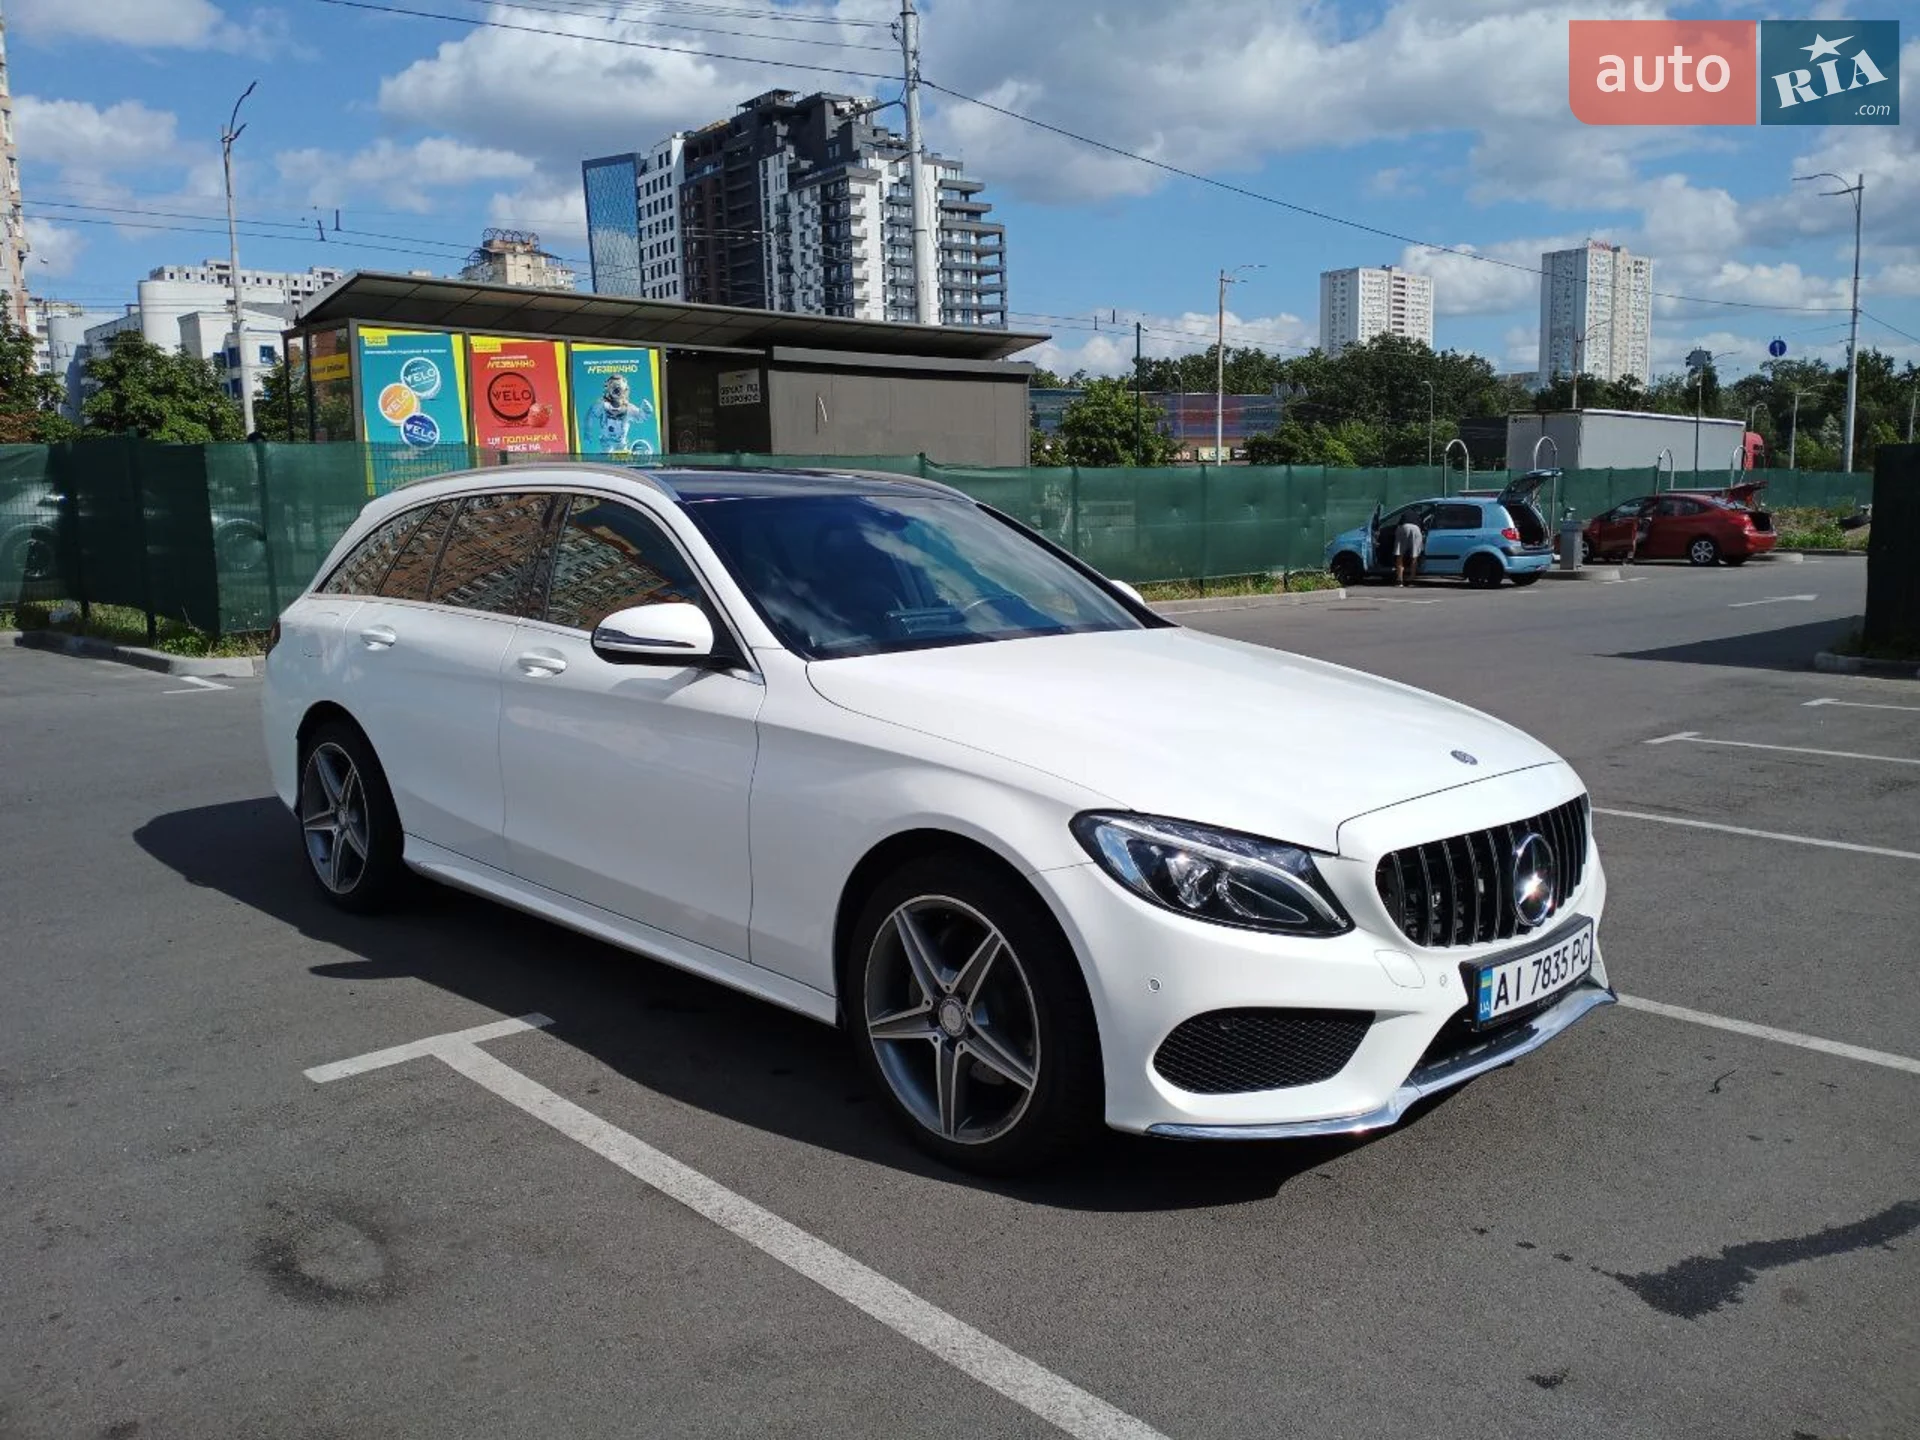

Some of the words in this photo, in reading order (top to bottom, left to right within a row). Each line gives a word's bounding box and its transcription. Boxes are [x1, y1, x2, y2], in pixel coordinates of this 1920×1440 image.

[404, 367, 437, 384] VELO
[385, 389, 411, 415] VELO
[492, 389, 532, 401] VELO
[405, 423, 437, 440] VELO
[502, 433, 558, 445] ПОЛУНИЧКА
[529, 443, 541, 451] НА
[1493, 966, 1522, 1010] AI
[1530, 945, 1569, 996] 7835
[1571, 932, 1590, 974] PC
[1480, 1000, 1491, 1014] UA
